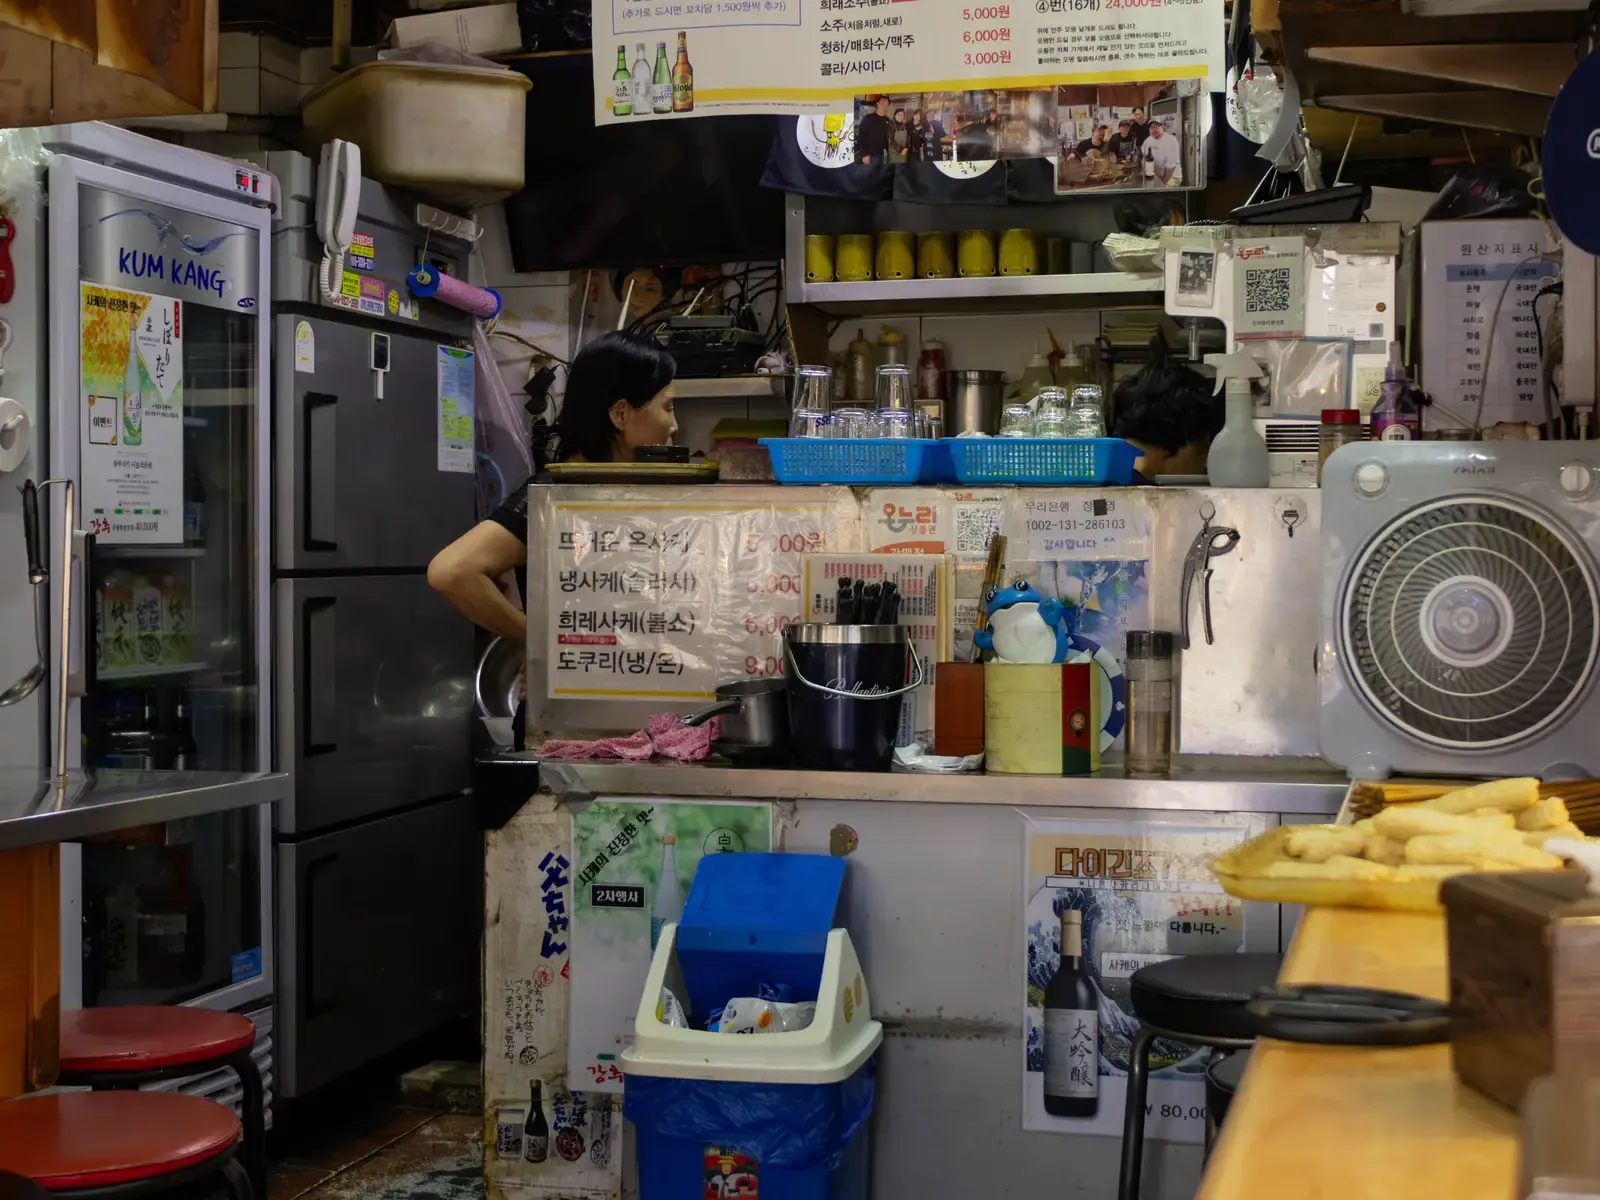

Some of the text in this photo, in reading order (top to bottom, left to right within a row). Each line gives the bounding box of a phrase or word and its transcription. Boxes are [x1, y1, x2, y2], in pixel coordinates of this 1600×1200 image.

[654, 6, 682, 17] 드시면
[685, 4, 713, 15] 꼬치당
[716, 1, 761, 13] 1,500원씩
[764, 1, 787, 11] 추가)
[962, 5, 1011, 21] 5,000원
[820, 16, 903, 33] 소주(처음처럼,새로)
[963, 27, 1011, 44] 6,000원
[820, 34, 916, 55] 청하/매화수/맥주
[964, 50, 1011, 65] 3,000원
[820, 59, 886, 76] 콜라/사이다
[119, 247, 226, 299] KUM KANG
[93, 416, 113, 428] 이벤트
[1024, 499, 1116, 513] 우리은행 장영
[878, 502, 937, 533] 온누리
[1025, 518, 1126, 532] 1002-131-286103
[907, 524, 937, 536] 상품권
[1043, 538, 1098, 552] 감사합니다
[557, 651, 685, 676] 도쿠리(냉/온)
[577, 853, 610, 887] 사케의
[606, 823, 639, 856] 진정한
[1055, 847, 1158, 879] 다이긴조
[596, 889, 639, 903] 2차행사
[1108, 959, 1139, 972] 사케의
[586, 1063, 624, 1084] 강추
[1160, 1102, 1207, 1121] 80,00
